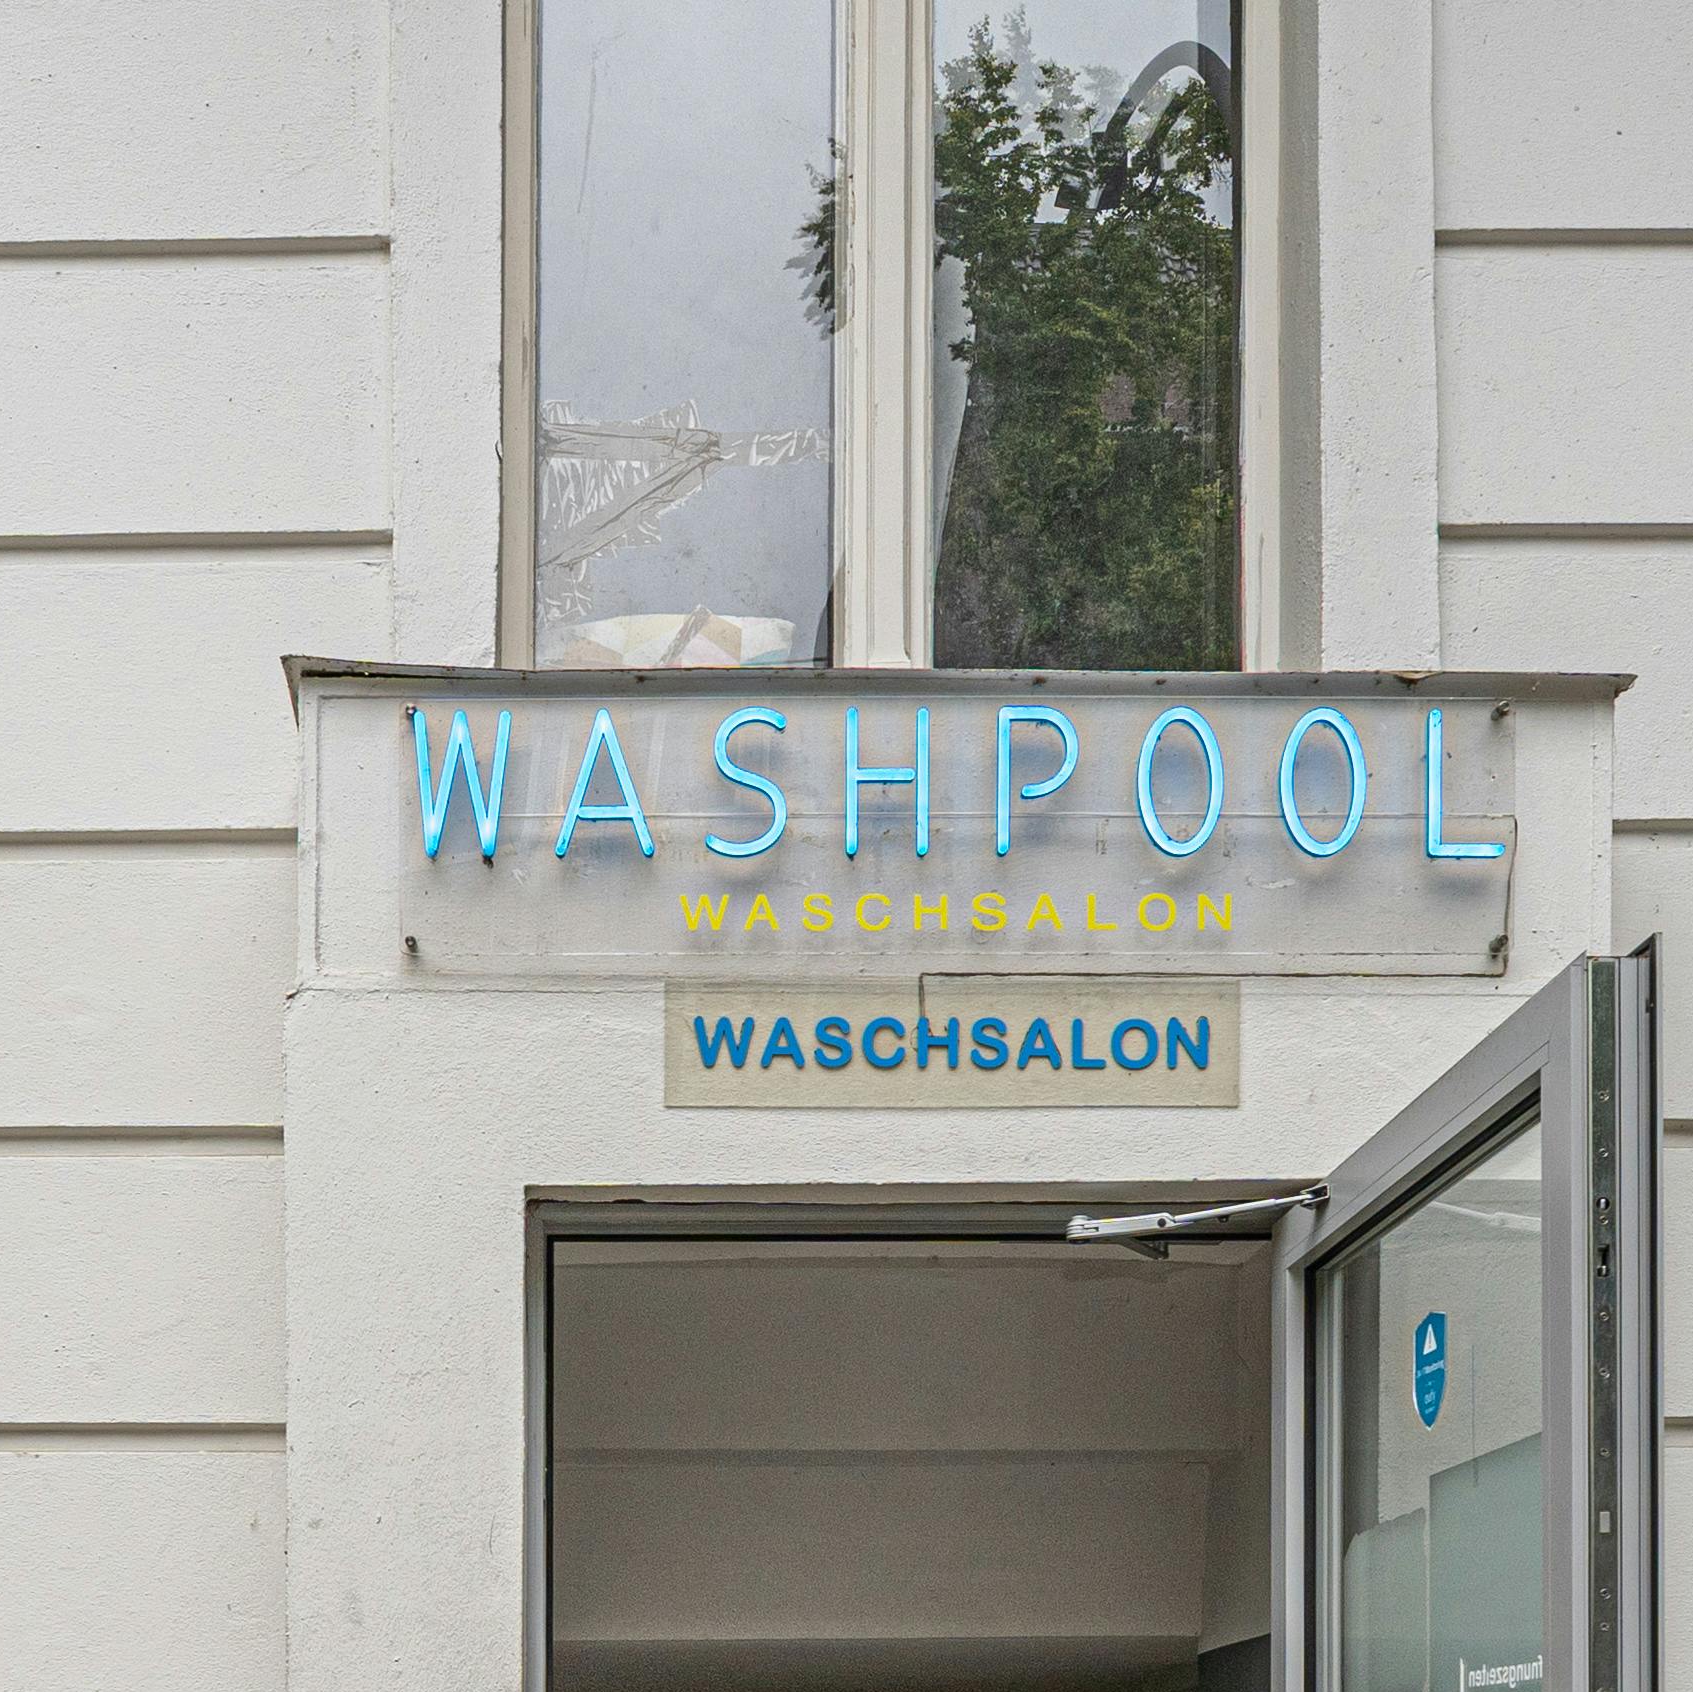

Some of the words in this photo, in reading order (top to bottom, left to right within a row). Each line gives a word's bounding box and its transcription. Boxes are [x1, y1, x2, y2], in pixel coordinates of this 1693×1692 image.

[411, 704, 1506, 858] WASHPOOL
[679, 892, 1233, 932] WASCHSALON
[693, 1016, 1210, 1070] WASCHSALON
